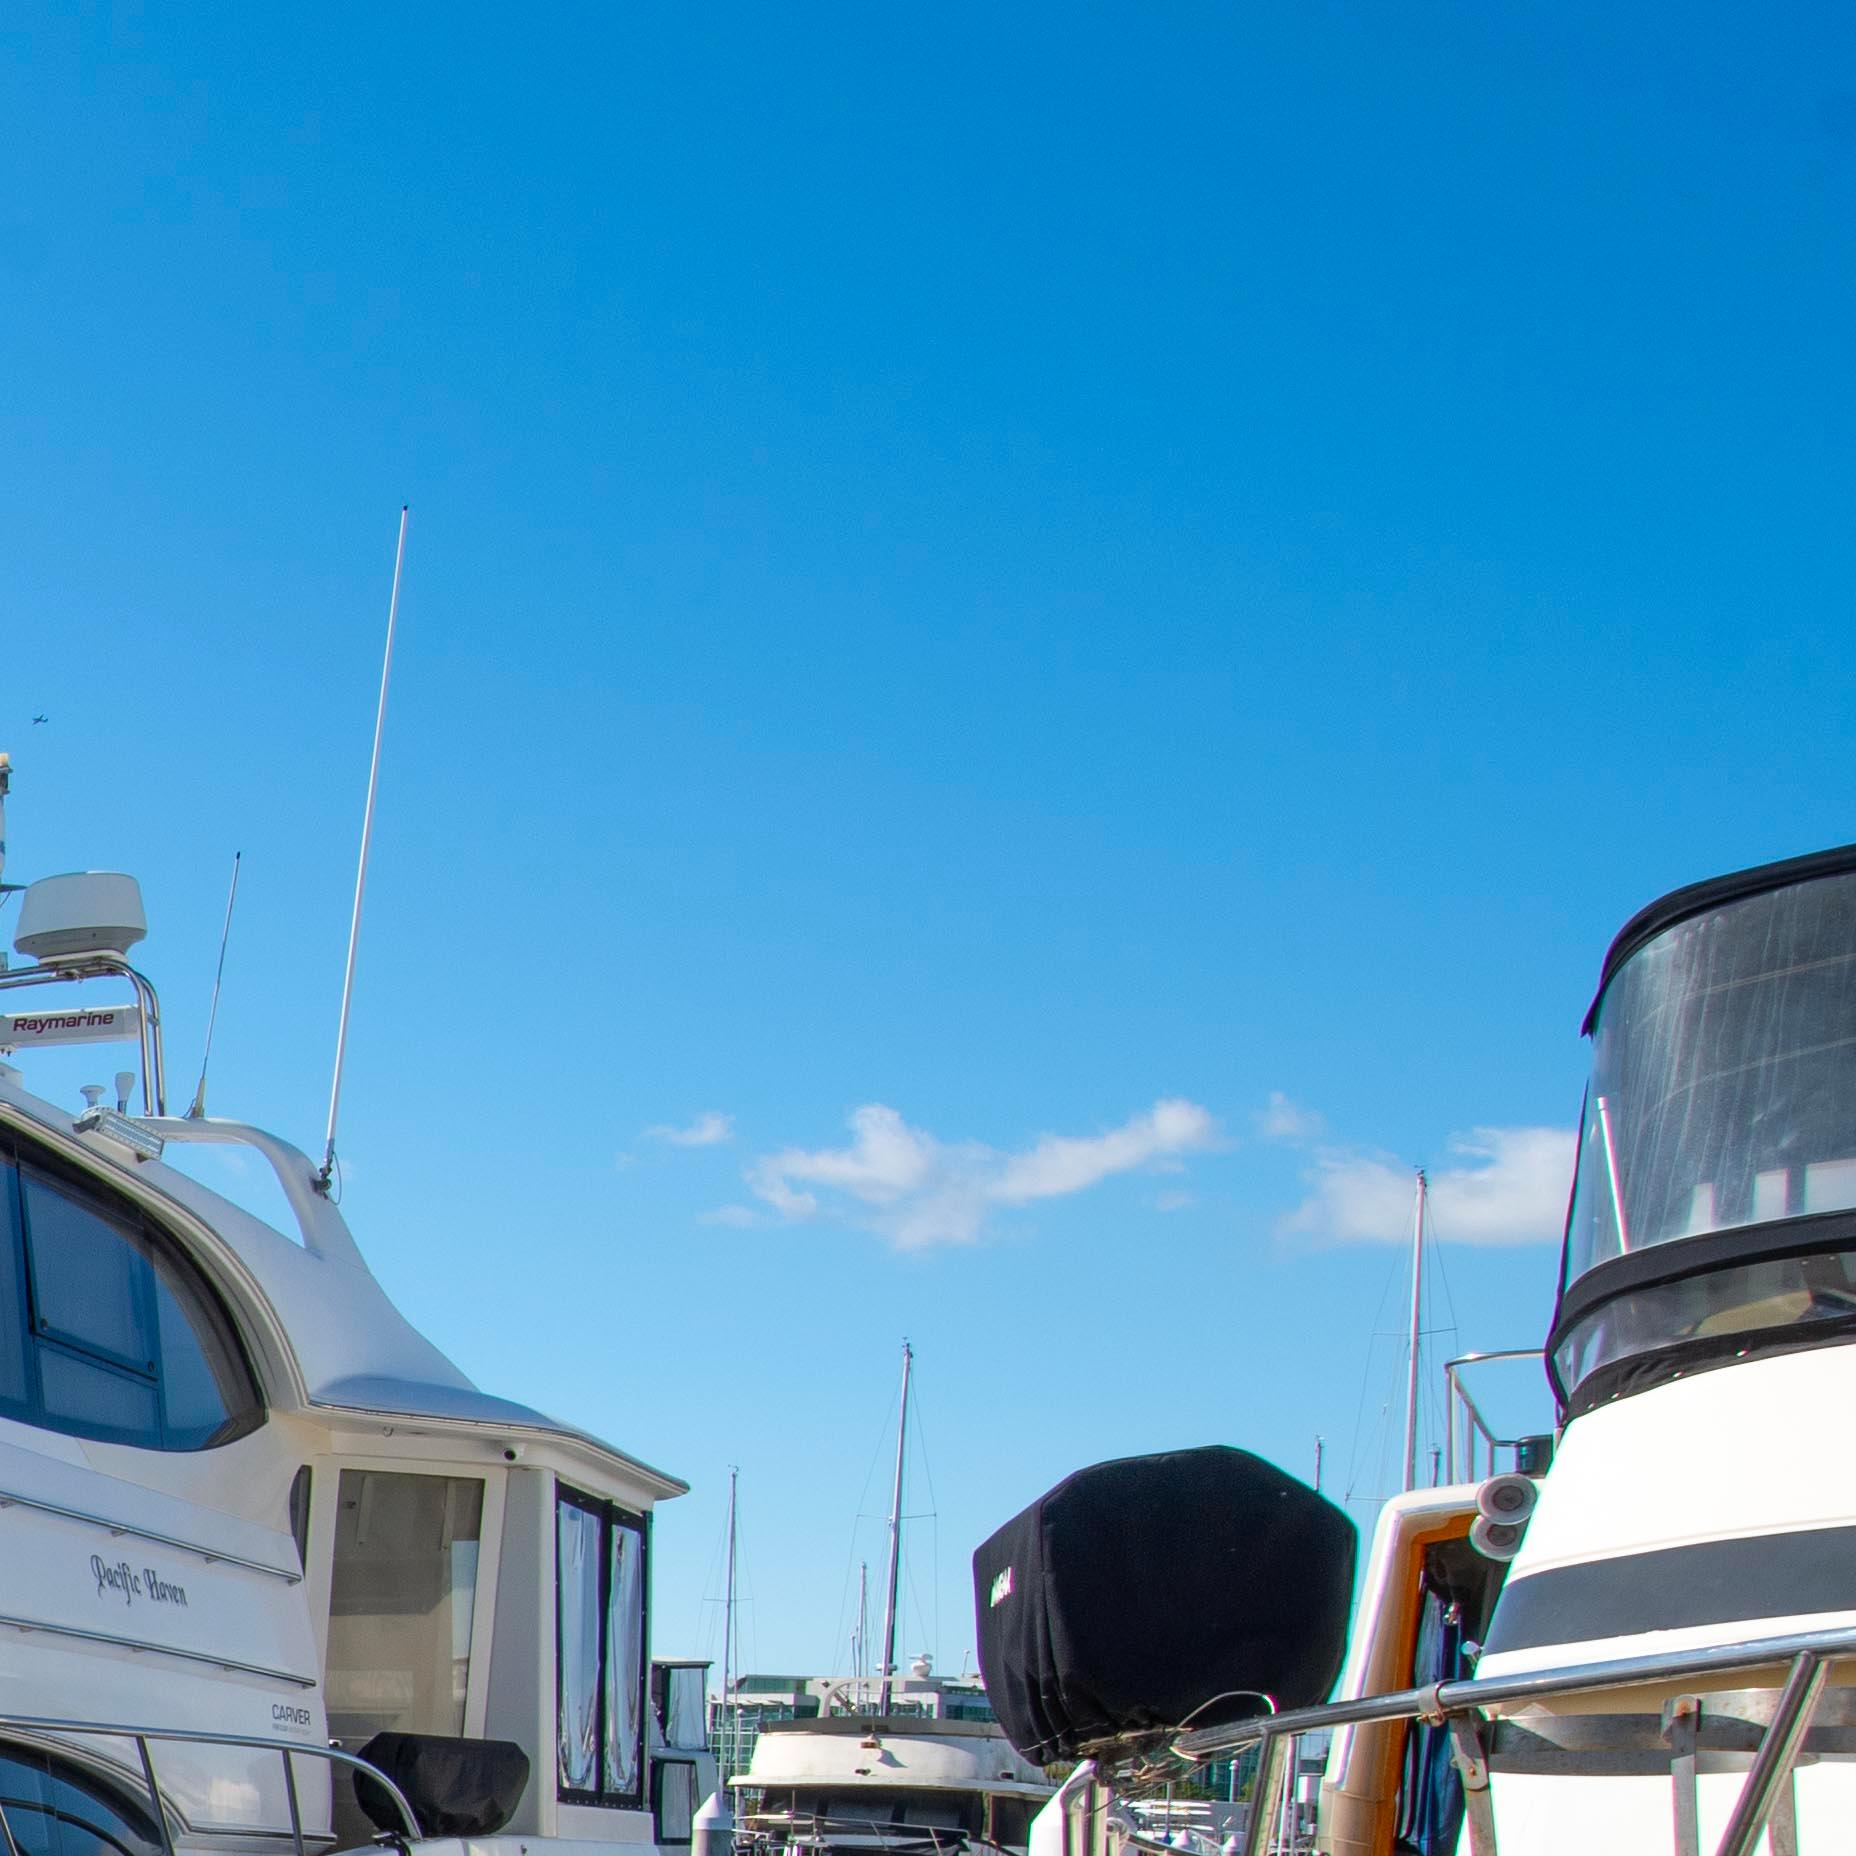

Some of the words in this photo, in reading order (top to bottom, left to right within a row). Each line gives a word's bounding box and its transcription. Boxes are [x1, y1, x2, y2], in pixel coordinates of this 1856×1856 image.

[13, 1012, 114, 1034] Raymarine
[90, 1554, 141, 1605] Pacific
[143, 1568, 188, 1606] Haven
[272, 1704, 311, 1726] CARVER
